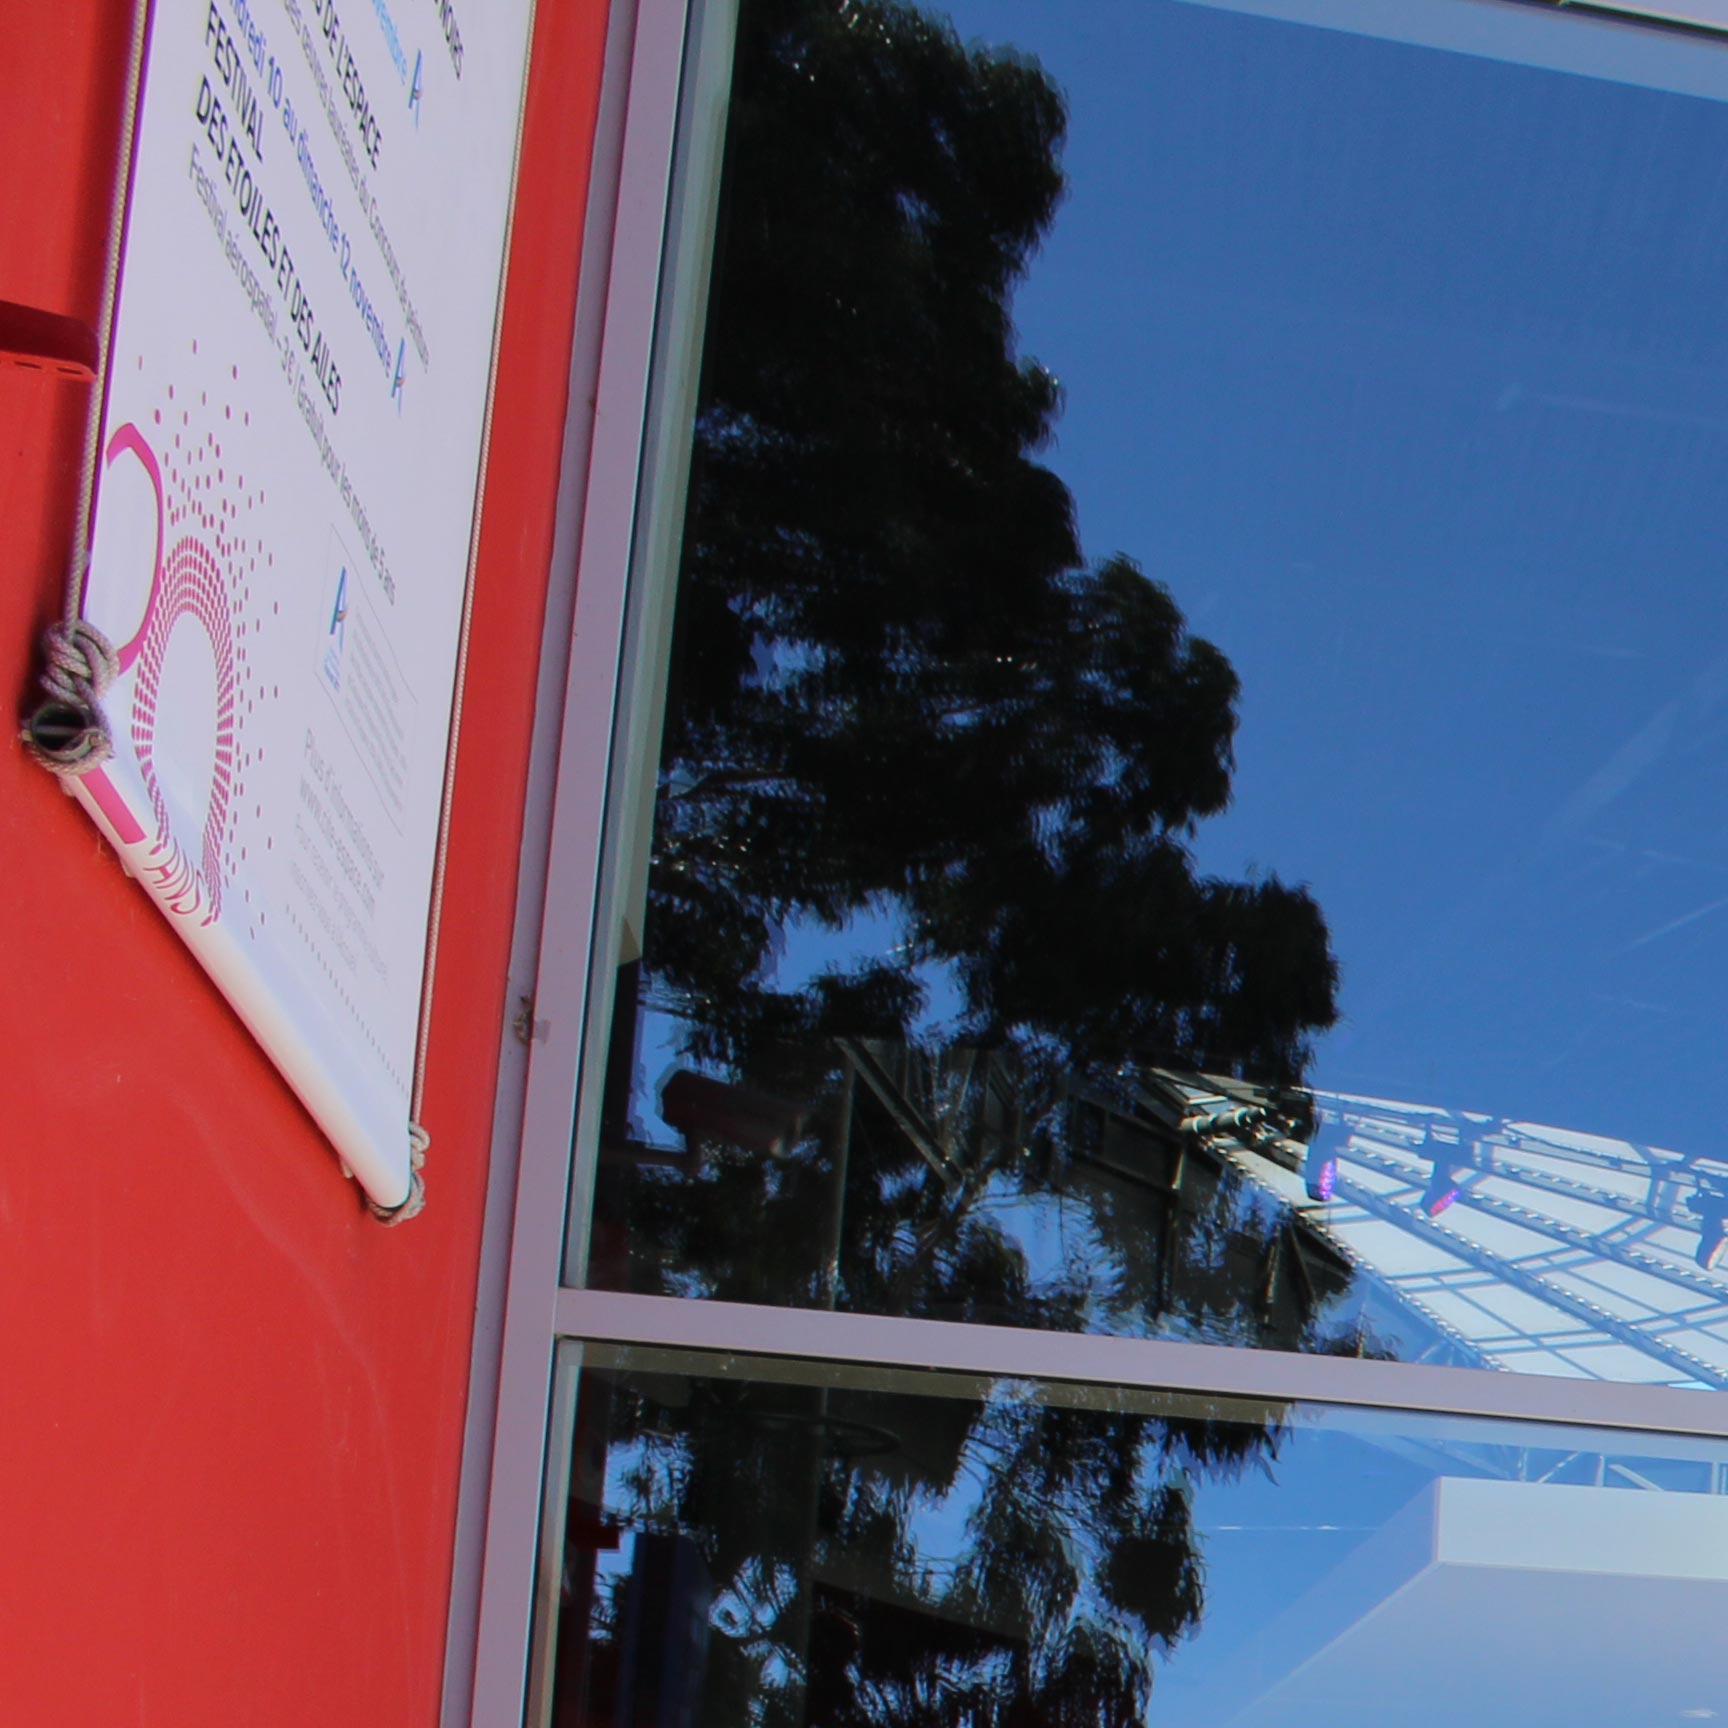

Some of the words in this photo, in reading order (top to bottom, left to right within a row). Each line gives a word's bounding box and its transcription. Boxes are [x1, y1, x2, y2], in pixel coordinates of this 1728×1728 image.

[204, 1, 264, 164] FESTIVAL
[336, 34, 382, 171] L'ESPACE
[188, 142, 228, 246] Festival
[195, 74, 229, 162] DES
[225, 135, 280, 270] ETOILES
[277, 244, 295, 301] ET
[291, 277, 315, 352] DES
[310, 330, 343, 416] AILES
[267, 56, 284, 109] 10
[283, 97, 298, 146] au
[297, 127, 341, 253] dimanche
[340, 232, 351, 282] 12
[350, 266, 392, 379] novembre
